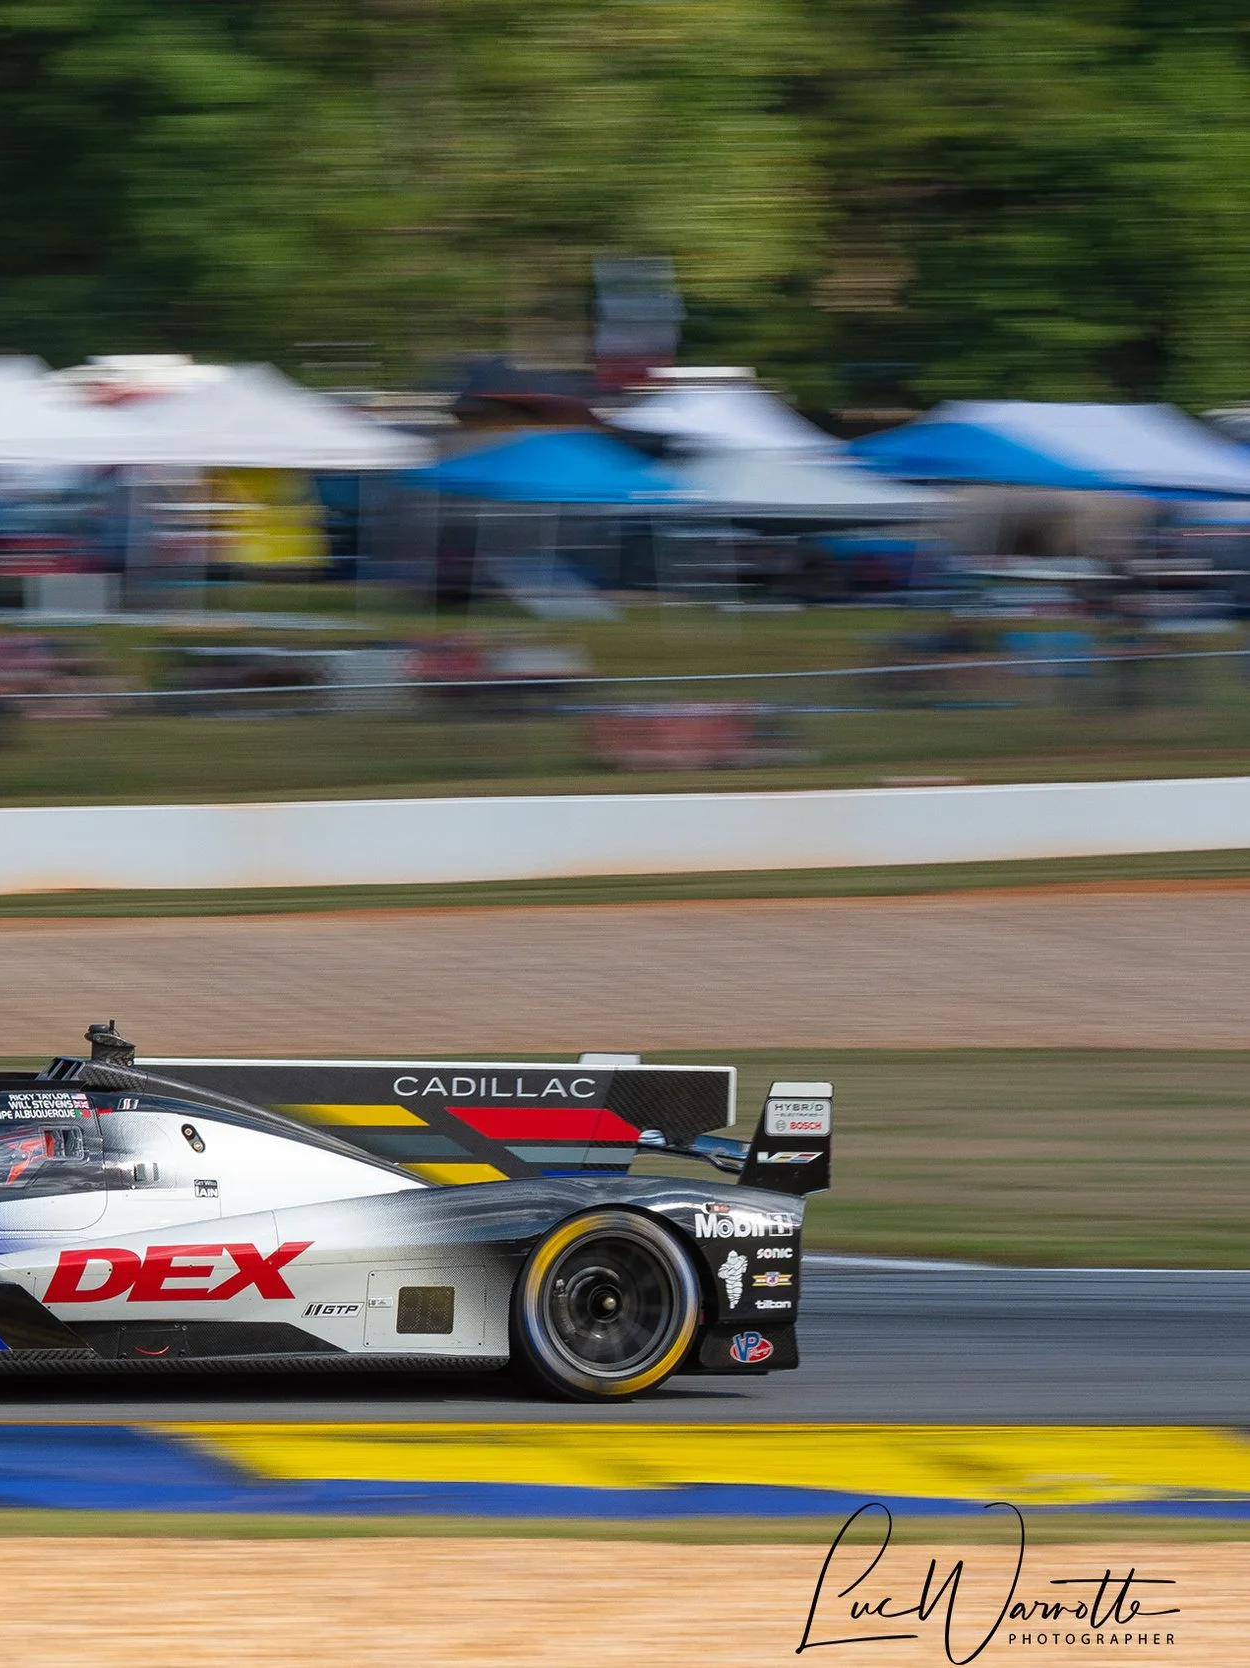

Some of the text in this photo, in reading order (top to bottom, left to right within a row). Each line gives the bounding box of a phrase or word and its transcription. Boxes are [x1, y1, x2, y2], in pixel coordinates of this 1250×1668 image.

[392, 1076, 597, 1099] CADILLAC
[8, 1093, 71, 1102] RICKY TAYLOR
[7, 1100, 74, 1110] WILL STEVENS
[774, 1103, 824, 1112] HYBRID
[14, 1109, 76, 1119] ALBUQUERQUE
[790, 1121, 823, 1131] BOSCH
[41, 1241, 316, 1304] DEX
[322, 1305, 359, 1315] GTP
[733, 1332, 763, 1362] VP
